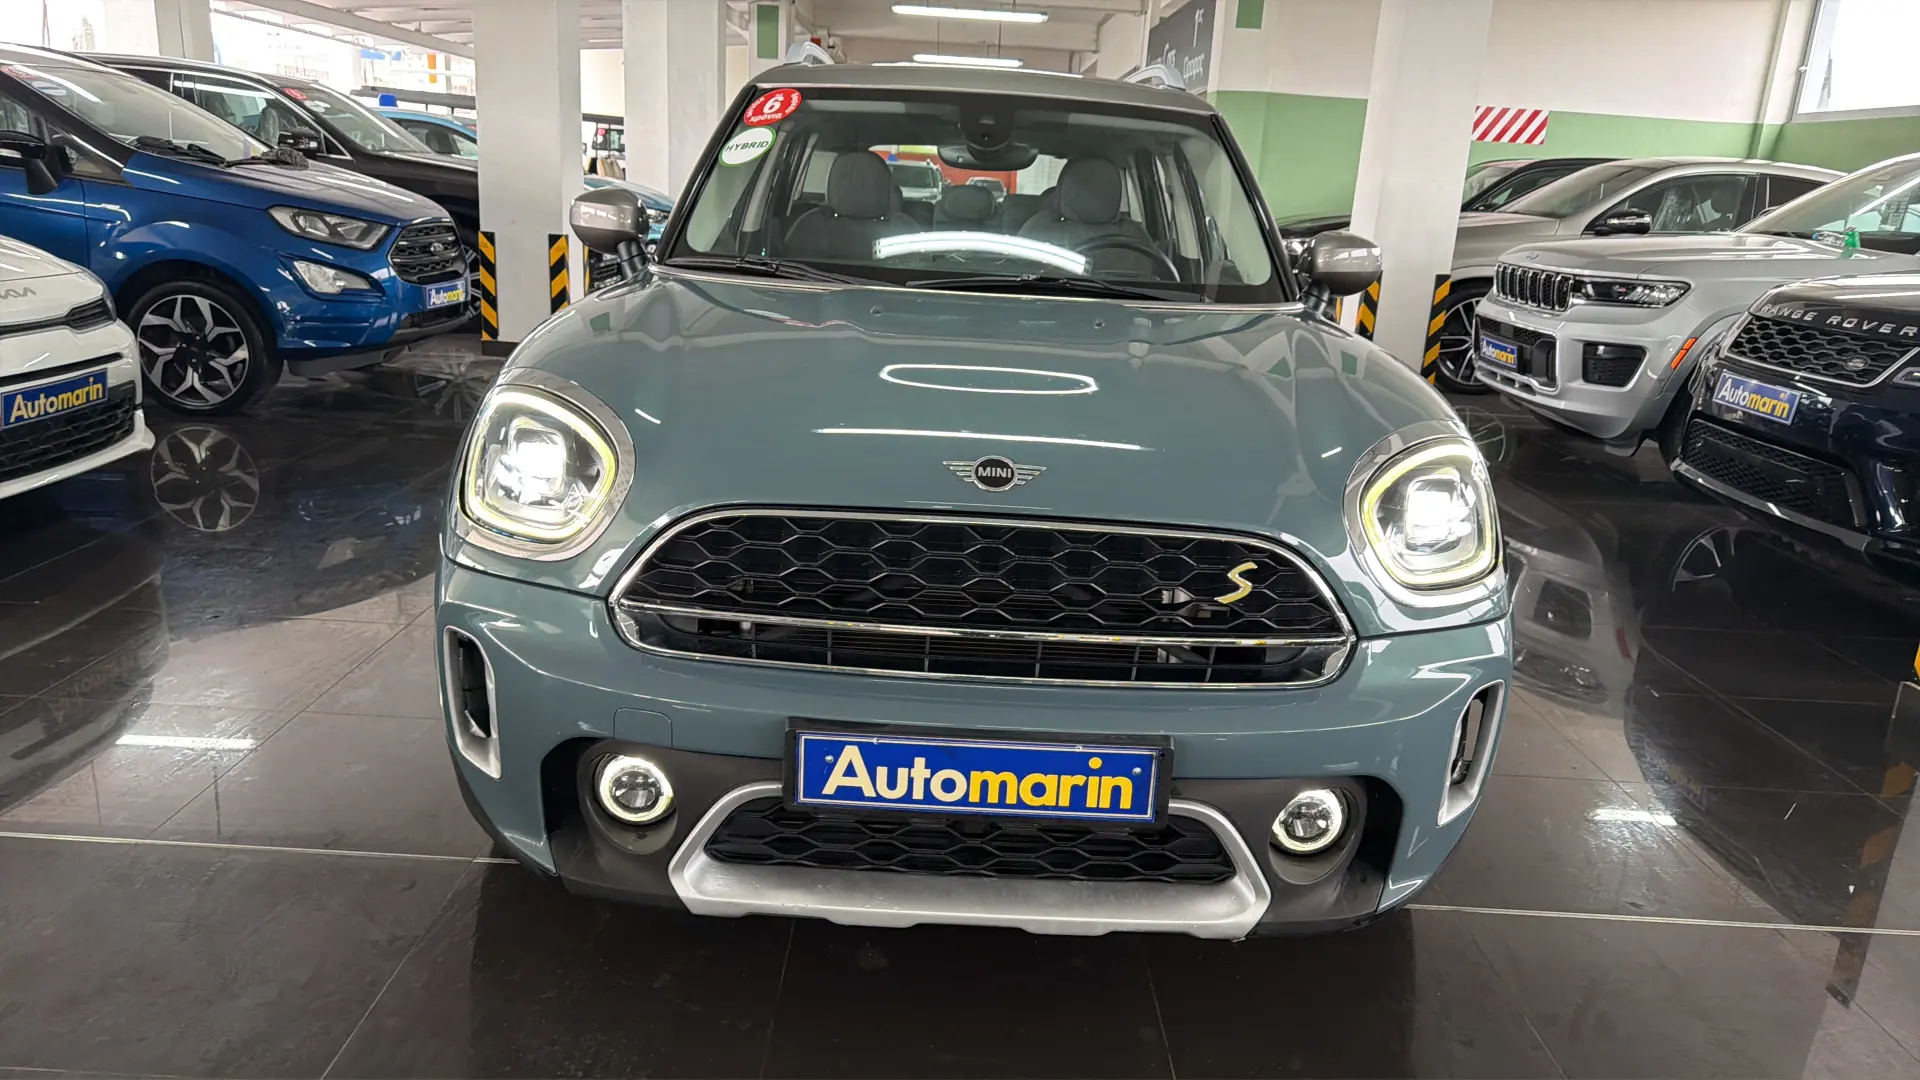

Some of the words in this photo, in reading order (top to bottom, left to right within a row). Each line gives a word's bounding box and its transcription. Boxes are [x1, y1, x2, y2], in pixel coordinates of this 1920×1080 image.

[763, 96, 784, 114] 6
[724, 140, 770, 152] HYBRID
[1760, 303, 1818, 321] RANGE
[1826, 315, 1920, 337] ROVER
[9, 376, 104, 423] Automarin
[1717, 378, 1791, 419] Automarin
[977, 466, 1012, 478] MINI
[821, 744, 1133, 810] Automarin
